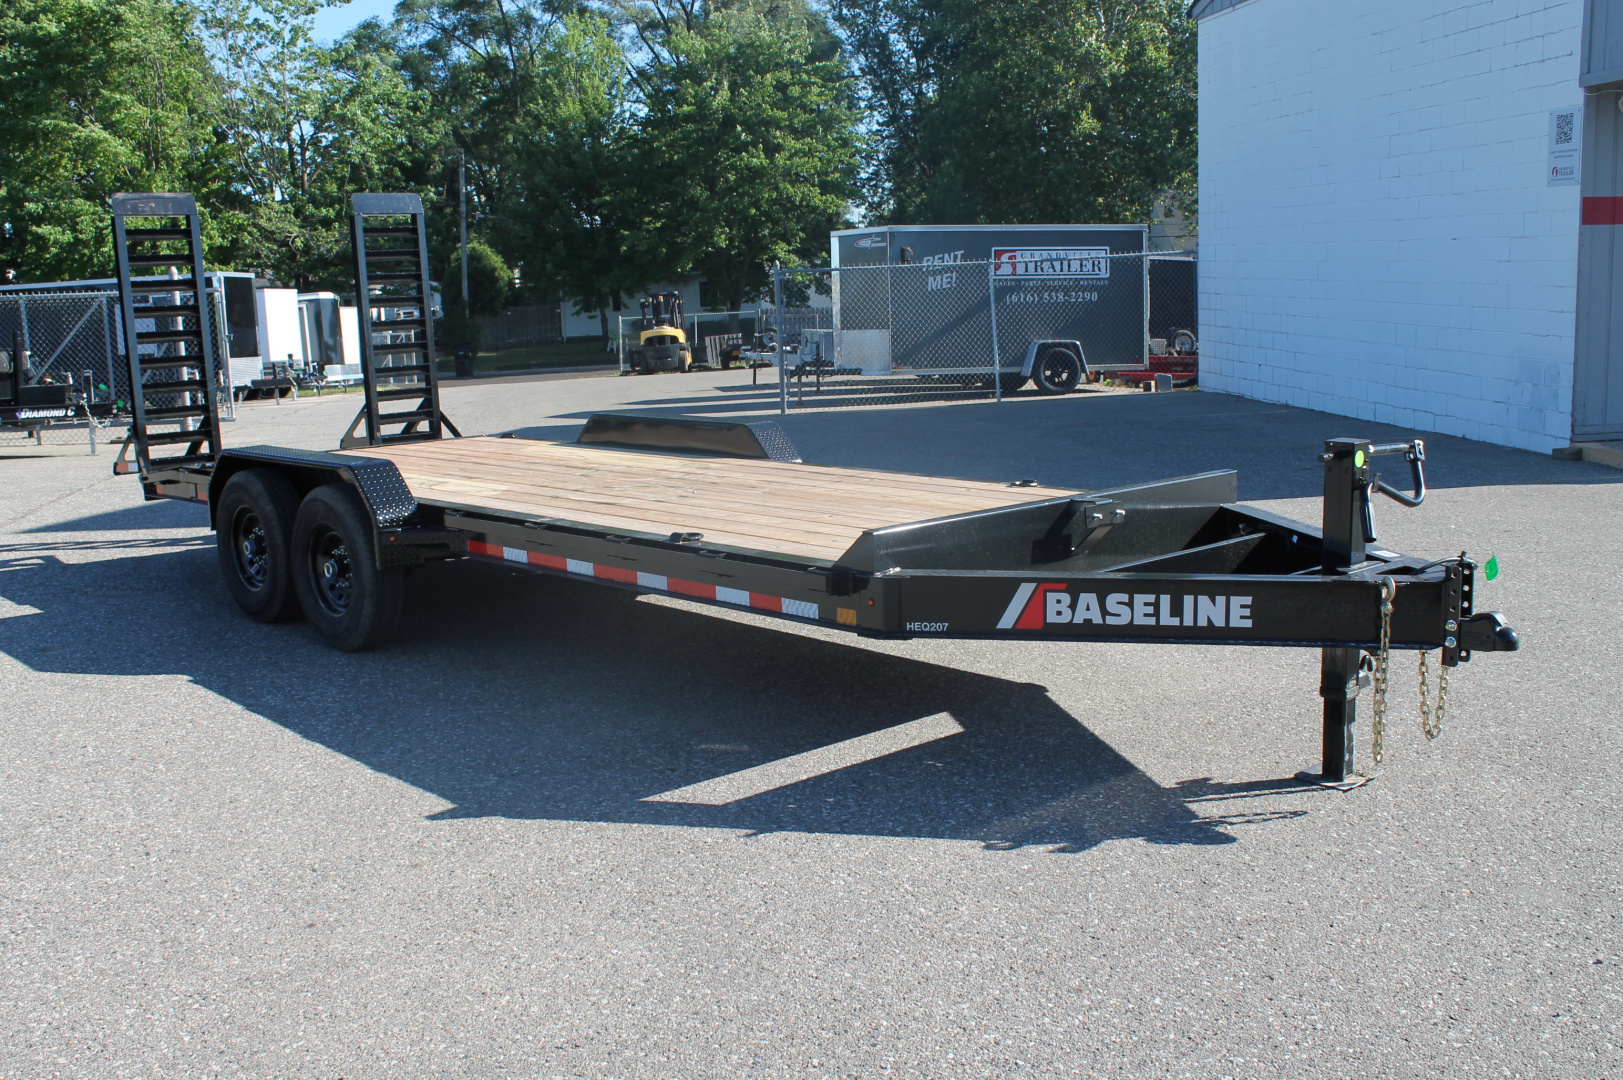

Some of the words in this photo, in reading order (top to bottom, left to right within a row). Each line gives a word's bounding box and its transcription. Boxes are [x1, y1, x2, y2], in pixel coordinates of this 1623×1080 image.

[922, 250, 965, 271] RENT
[1022, 259, 1103, 273] TRAILER
[927, 271, 957, 291] ME!
[1006, 292, 1038, 304] (616)
[1043, 291, 1098, 303] 538-2290
[20, 408, 66, 418] DIAMOND
[66, 406, 76, 416] C
[1046, 591, 1253, 628] BASELINE
[906, 622, 949, 632] HEQ207
